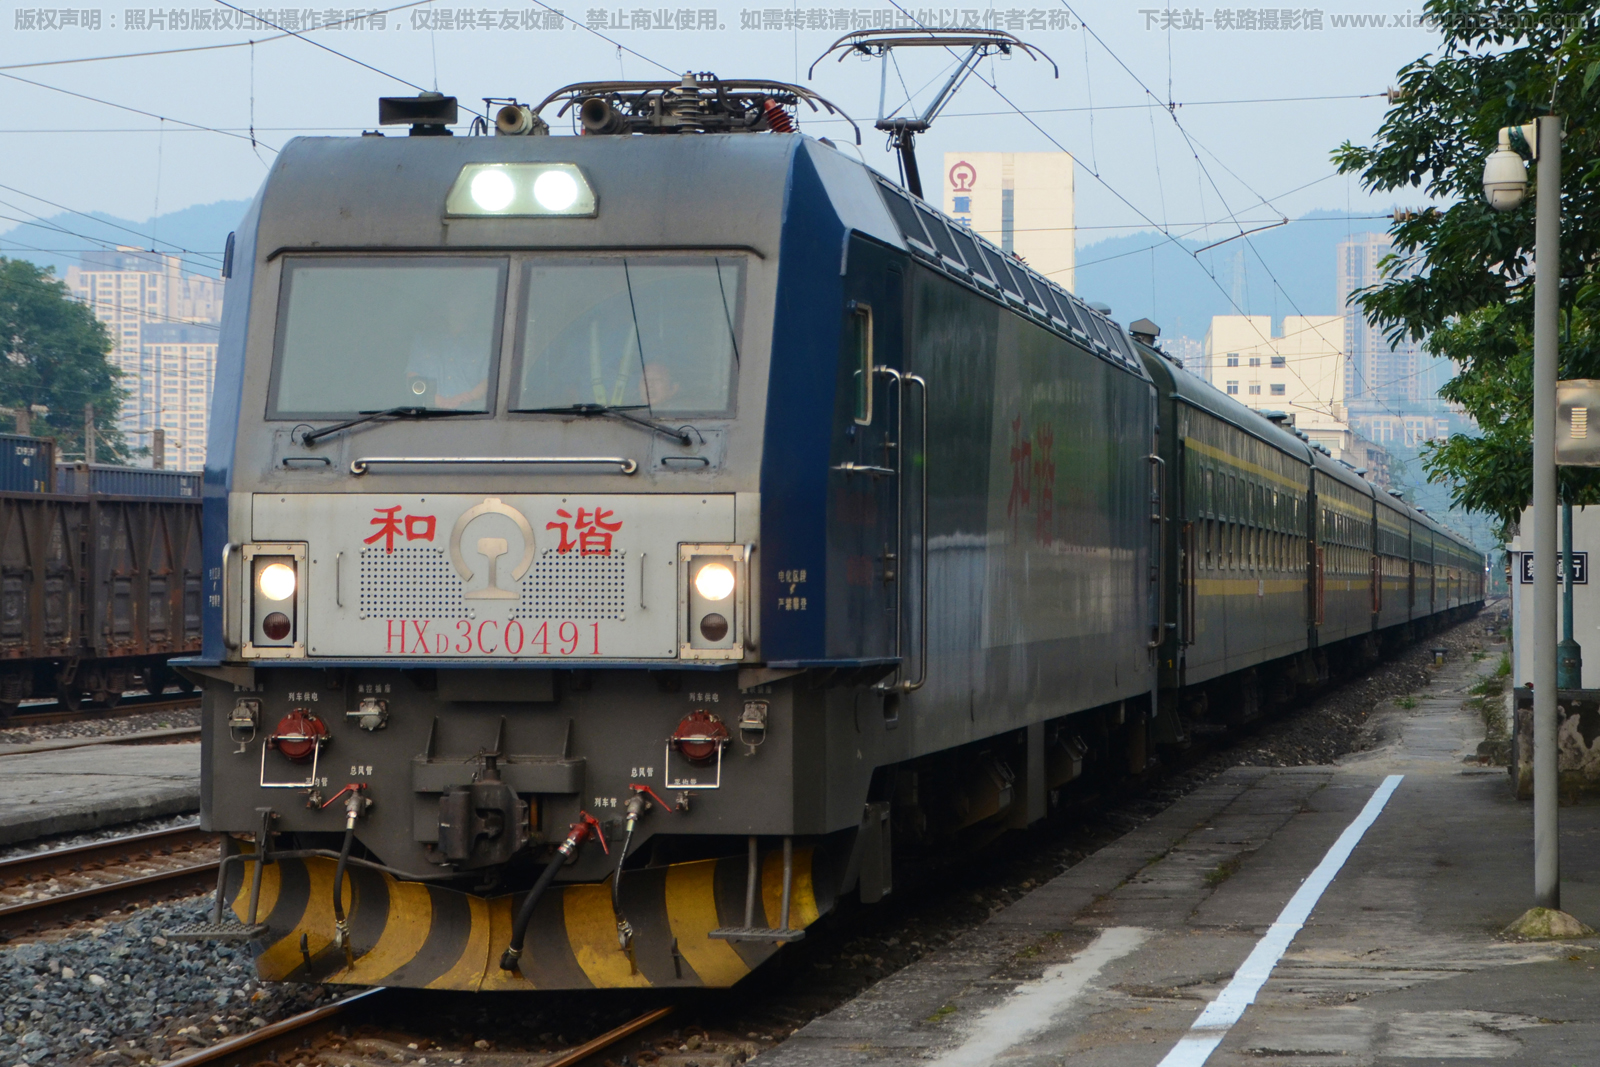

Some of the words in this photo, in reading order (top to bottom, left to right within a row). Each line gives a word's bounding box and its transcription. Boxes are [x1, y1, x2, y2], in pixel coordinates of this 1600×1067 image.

[363, 504, 437, 555] 和
[545, 506, 624, 557] 谐
[288, 692, 319, 703] 列车供电
[688, 692, 719, 703] 列车供电
[350, 765, 373, 776] 总风管
[630, 767, 654, 777] 总风管
[594, 797, 617, 808] 列车管
